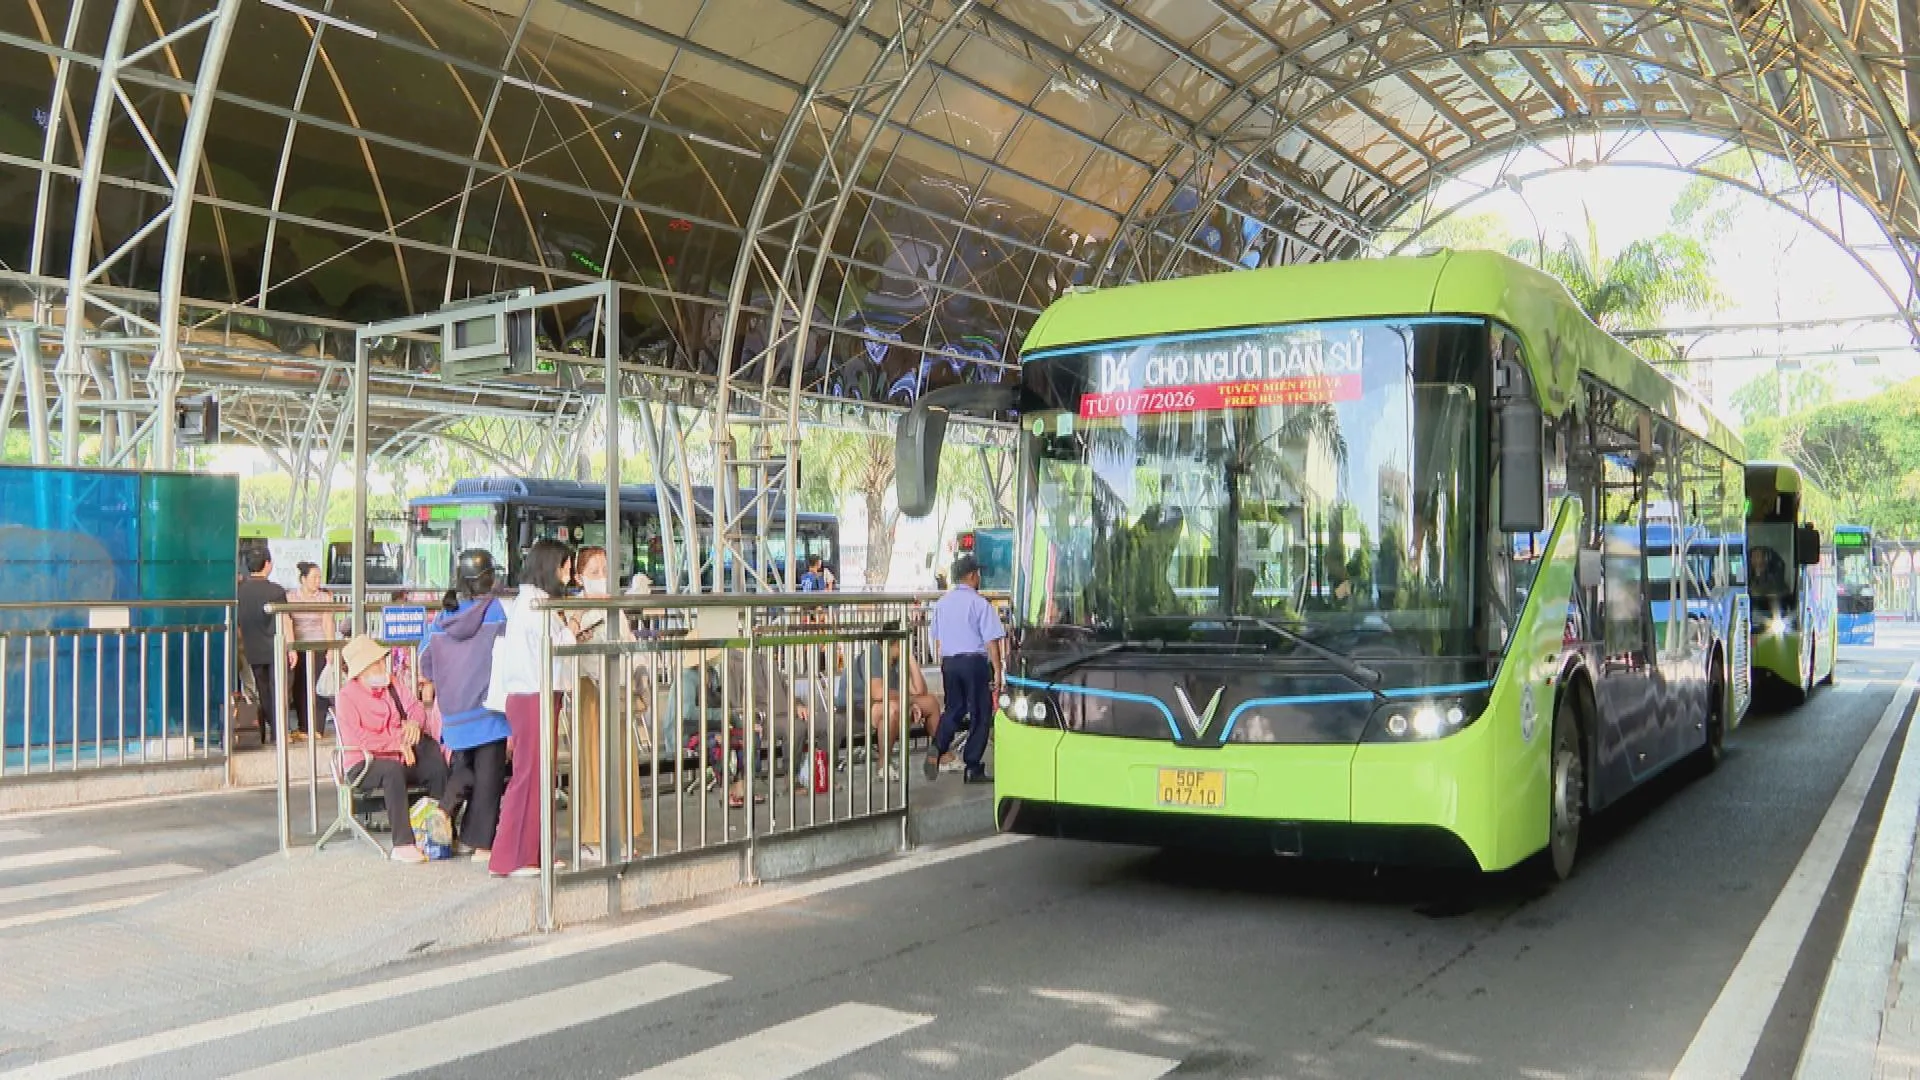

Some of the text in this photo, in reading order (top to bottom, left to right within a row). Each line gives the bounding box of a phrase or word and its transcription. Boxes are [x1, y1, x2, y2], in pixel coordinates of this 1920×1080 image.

[1101, 352, 1130, 394] D4
[1145, 354, 1188, 386] CHO
[1194, 341, 1262, 382] NGƯỜI
[1268, 336, 1324, 379] DÂN
[1115, 388, 1195, 413] 01/7/2026
[1224, 395, 1257, 407] FREE
[1176, 770, 1205, 787] 50F
[1164, 787, 1217, 805] 017.10
